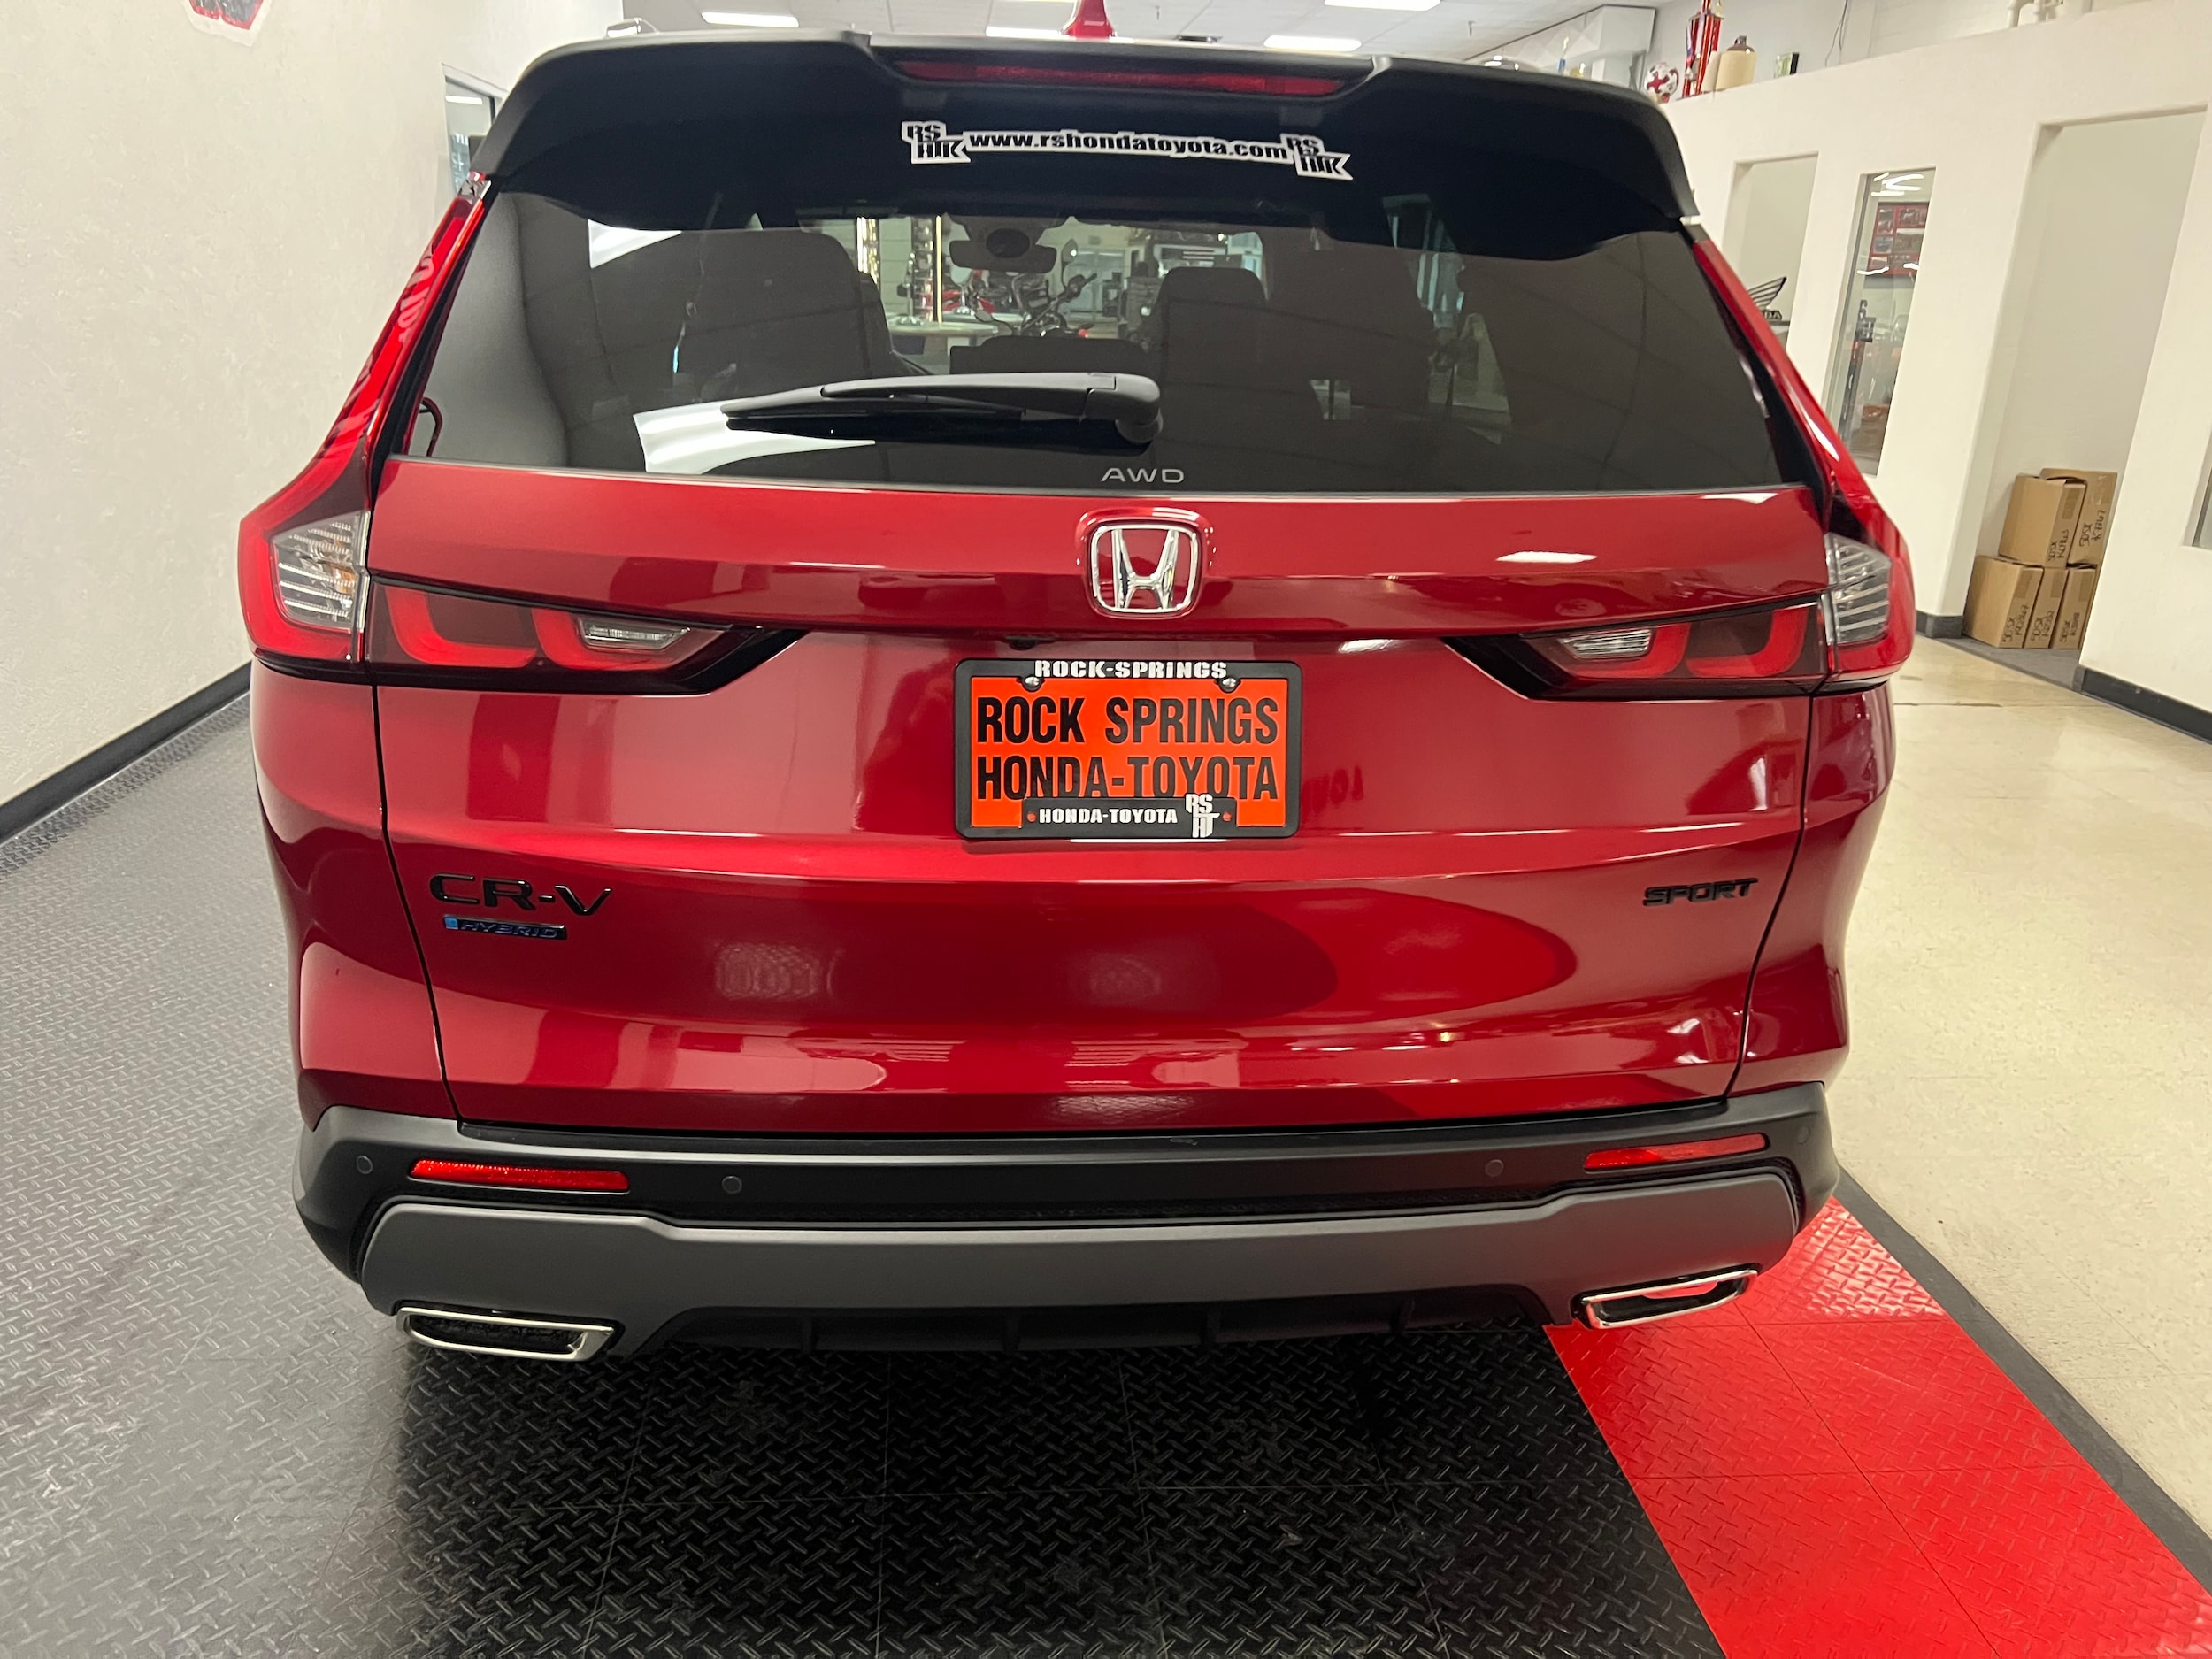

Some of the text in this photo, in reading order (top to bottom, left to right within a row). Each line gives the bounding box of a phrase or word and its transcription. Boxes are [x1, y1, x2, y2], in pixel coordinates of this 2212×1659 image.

[968, 131, 1288, 160] www.rshondatoyota.com
[1101, 467, 1185, 483] AWD
[1034, 660, 1228, 679] ROCK-SPRINGS
[977, 696, 1279, 744] ROCK SPRINGS
[977, 755, 1278, 800] HONDA-TOYOTA
[1039, 809, 1178, 824] HONDA-TOYOTA
[429, 873, 612, 916] CR-V
[1643, 878, 1758, 906] SPORT
[460, 920, 558, 939] HYBRID
